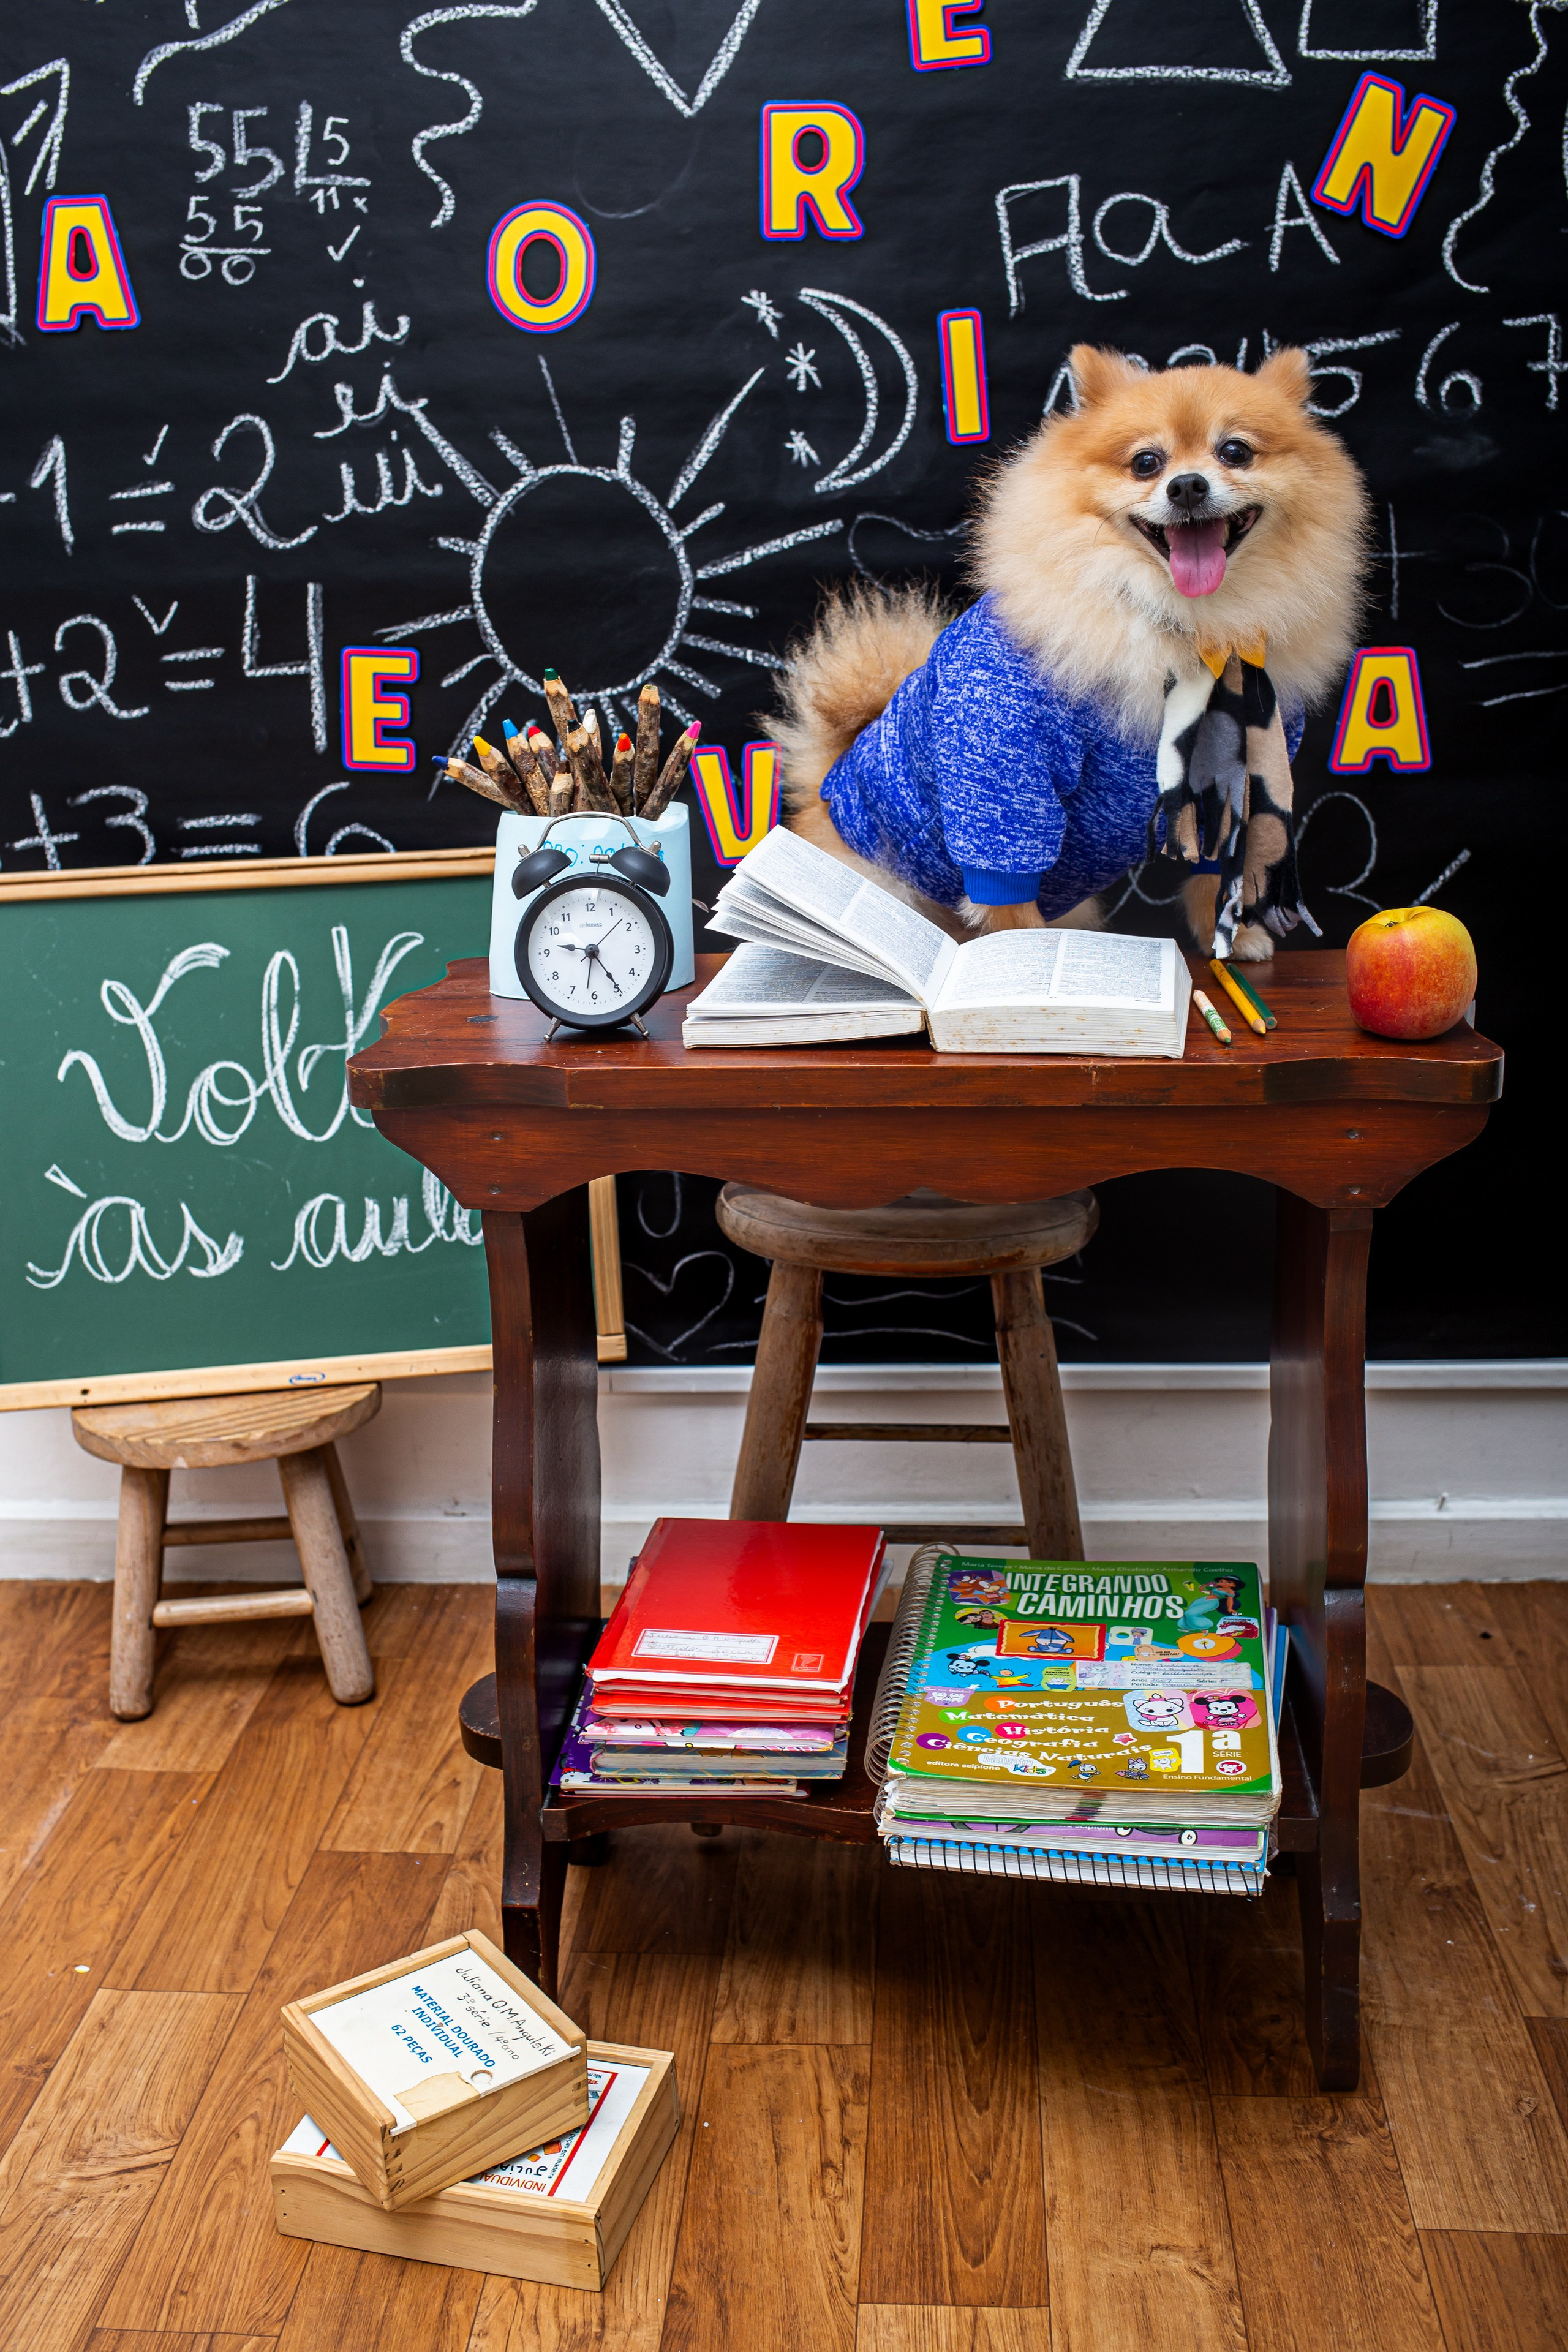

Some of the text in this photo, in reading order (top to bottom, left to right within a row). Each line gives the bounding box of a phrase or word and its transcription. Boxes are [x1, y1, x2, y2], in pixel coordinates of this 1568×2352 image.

[905, 0, 993, 72] E
[1310, 70, 1457, 239] N
[760, 100, 866, 241] R
[36, 194, 141, 333] A
[487, 199, 597, 334] O
[937, 307, 991, 446] I
[340, 645, 420, 774] E
[1328, 646, 1433, 775] A
[690, 739, 783, 869] V
[585, 902, 596, 912] 12
[561, 913, 570, 922] 11
[625, 922, 633, 932] 2
[548, 927, 560, 936] 10
[543, 949, 550, 958] 9
[634, 945, 641, 954] 3
[552, 971, 559, 980] 8
[628, 967, 636, 976] 4
[569, 986, 576, 995] 7
[591, 991, 598, 1000] 6
[57, 924, 424, 1145] Volt
[1006, 1572, 1169, 1594] INTEGRANDO
[1016, 1593, 1185, 1619] CAMINHOS
[996, 1700, 1125, 1710] Português
[944, 1711, 1095, 1722] Matemática
[966, 1732, 1099, 1749] Geografia
[1002, 1725, 1110, 1736] História
[926, 1739, 1152, 1762] Ciências Naturais
[961, 1762, 1001, 1771] scipione
[1012, 1763, 1047, 1775] Kids
[456, 1967, 492, 2002] Juliana
[411, 1985, 496, 2067] MATERIAL DOURADO
[412, 2007, 464, 2058] INDIVIDUAL
[391, 2024, 433, 2064] 62 PEÇAS
[565, 2133, 576, 2149] peças
[560, 2149, 567, 2158] em
[548, 2158, 562, 2179] madeira
[478, 2172, 546, 2192] INDIVIDUAL
